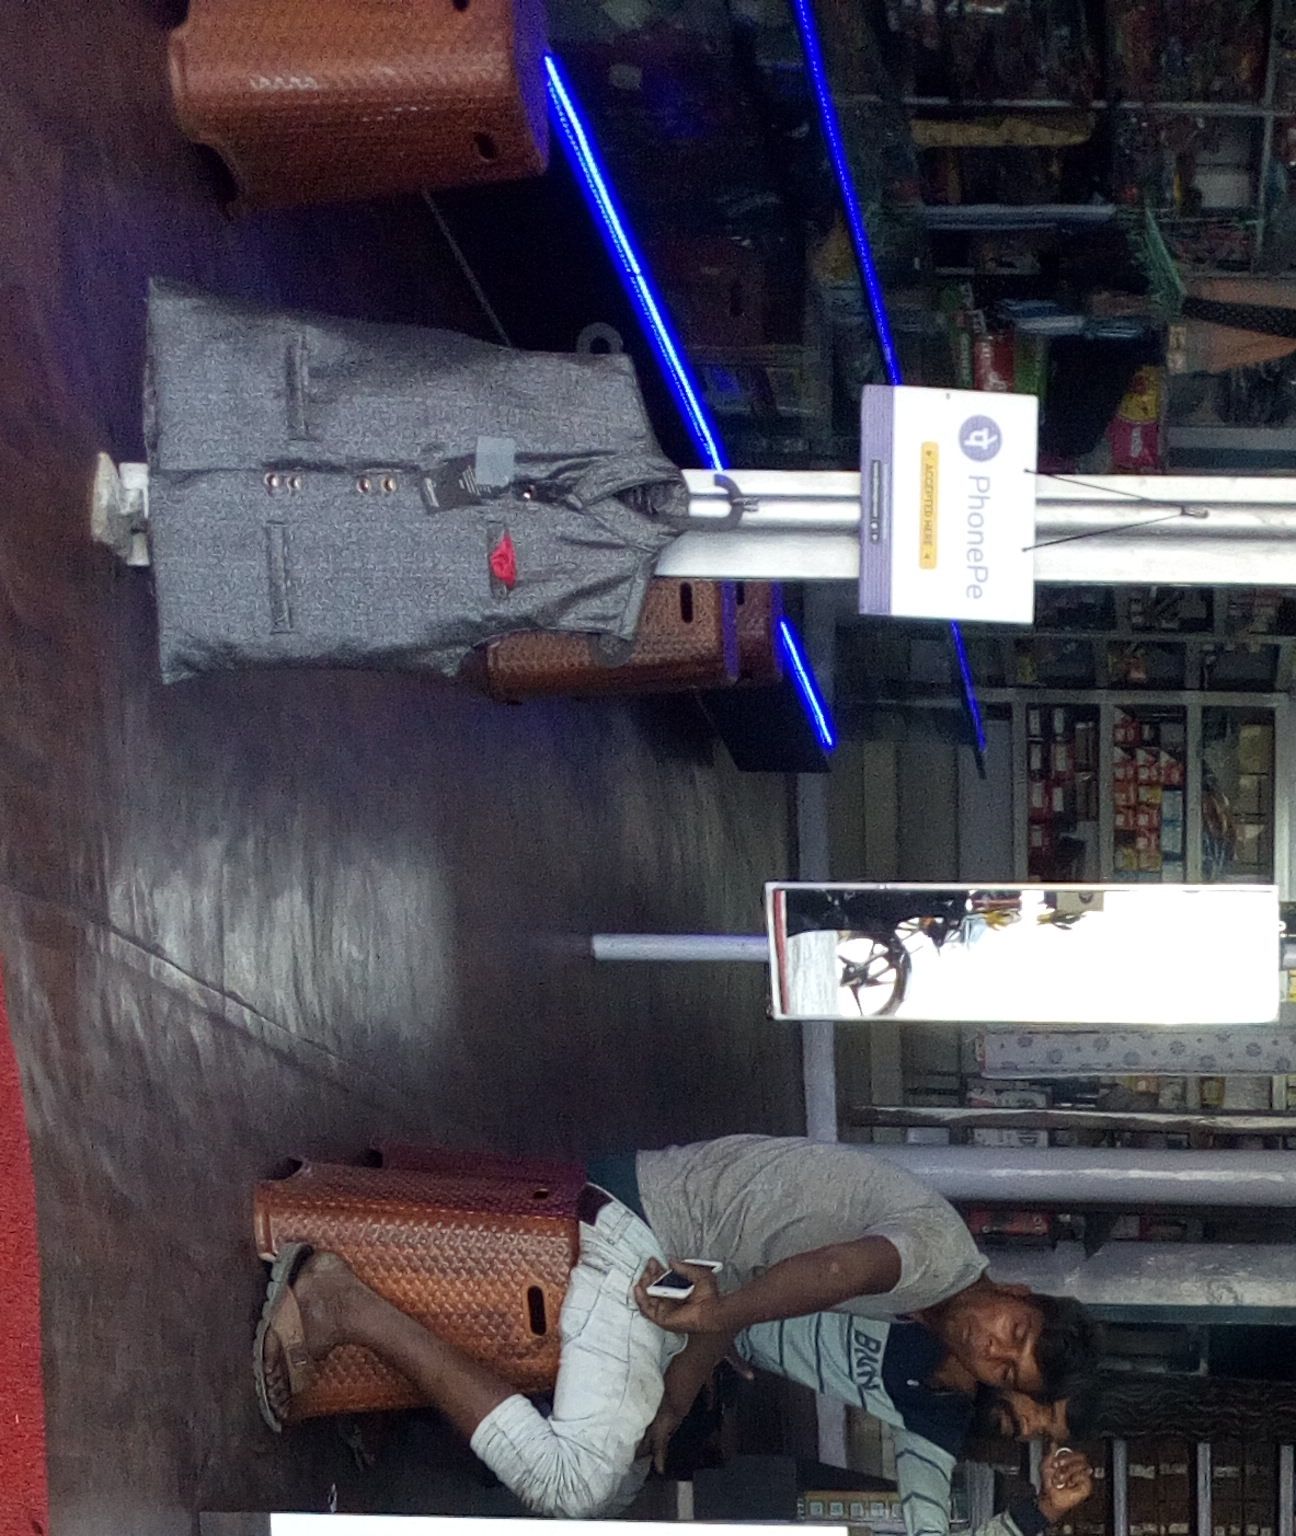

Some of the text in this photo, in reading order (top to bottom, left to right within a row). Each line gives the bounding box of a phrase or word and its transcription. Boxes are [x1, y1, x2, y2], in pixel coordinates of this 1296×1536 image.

[922, 463, 934, 546] ACCEPTED HERE
[966, 475, 991, 600] PhonePe
